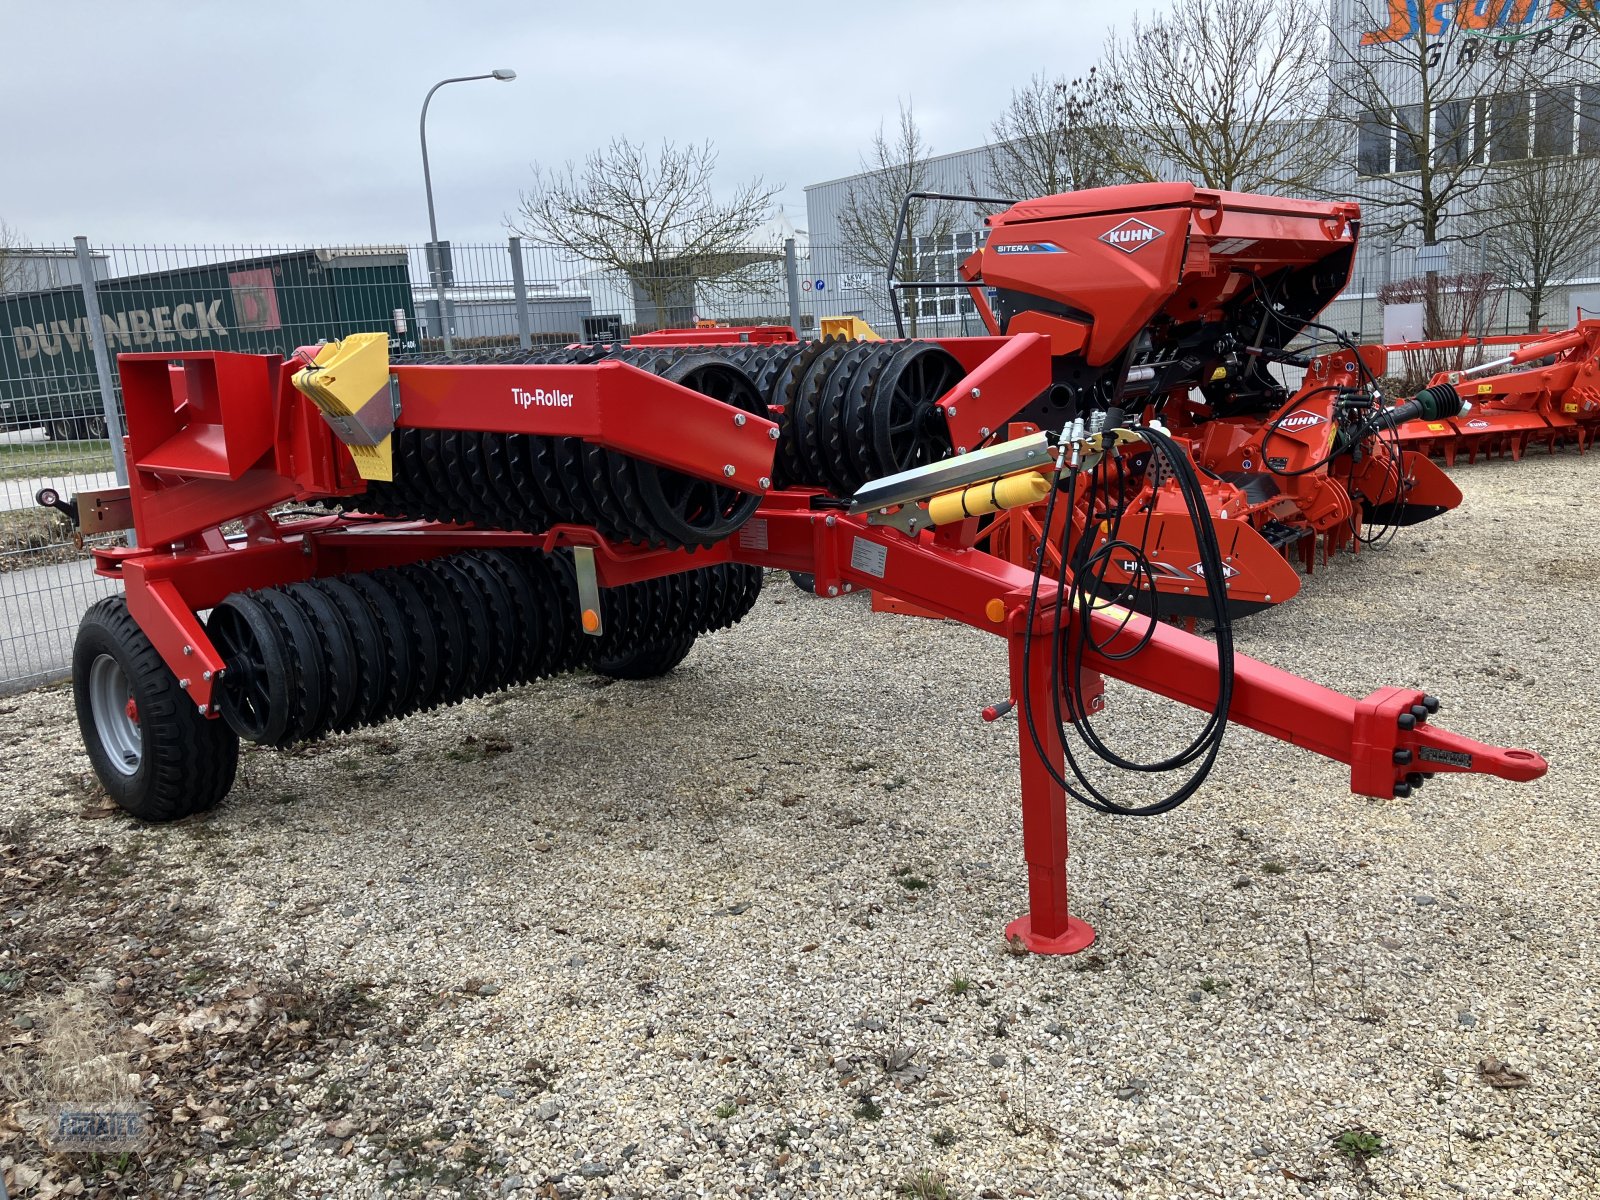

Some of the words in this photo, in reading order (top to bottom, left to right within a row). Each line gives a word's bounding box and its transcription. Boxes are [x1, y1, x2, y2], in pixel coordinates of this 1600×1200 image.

[1425, 25, 1600, 67] GRUPP
[1110, 228, 1153, 243] KUHN
[997, 244, 1030, 253] SITERA
[511, 388, 574, 410] Tip-Roller
[1278, 416, 1318, 427] KUHN
[1196, 564, 1231, 576] KN
